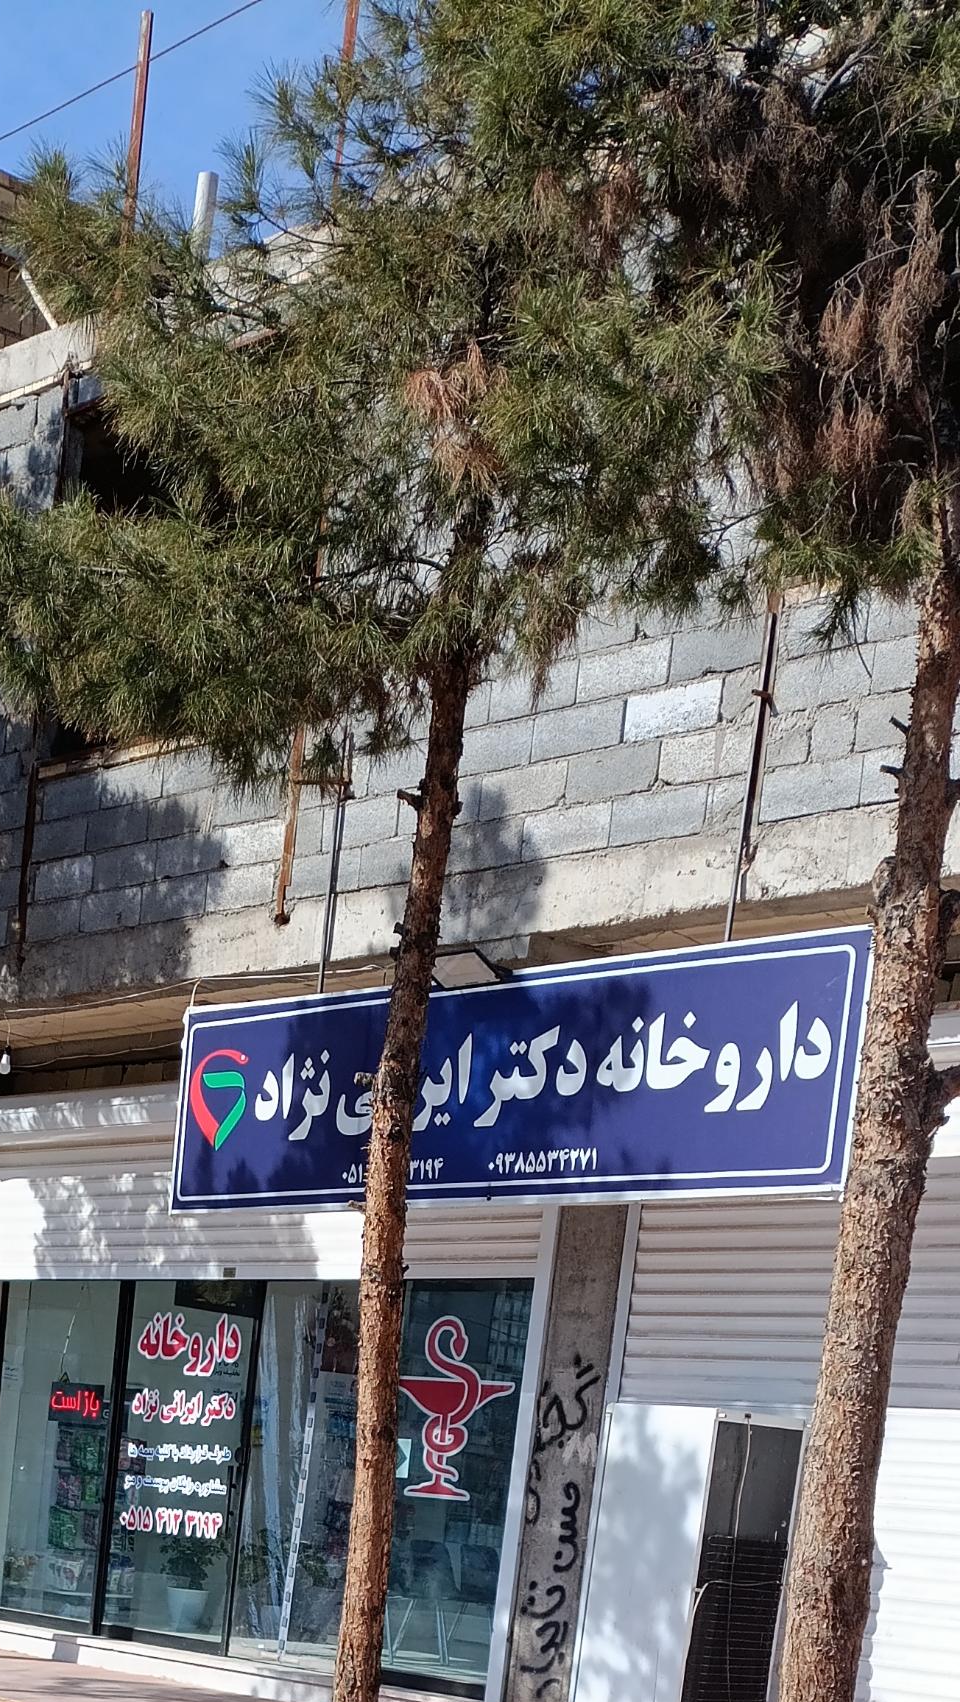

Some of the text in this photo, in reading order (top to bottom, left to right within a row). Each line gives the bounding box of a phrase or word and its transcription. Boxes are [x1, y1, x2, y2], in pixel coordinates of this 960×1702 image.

[254, 1000, 832, 1141] داروخانه دکتر ایری نژاد
[488, 1147, 598, 1175] ۰۹۳۸۵۵۳۴۲۷۱
[138, 1312, 241, 1376] داروخانه
[51, 1390, 100, 1417] باز است
[132, 1387, 160, 1422] نژاد
[160, 1389, 204, 1424] ایرانی
[201, 1392, 236, 1427] دکتر
[128, 1442, 138, 1457] ها
[138, 1444, 155, 1461] بیمه
[179, 1444, 208, 1465] قرارداد
[208, 1444, 232, 1465] طرف
[124, 1474, 227, 1497] مشاوره رایگان پوست و مو
[119, 1505, 153, 1532] ۰۵۱۵
[185, 1510, 222, 1539] ۳۱۹۴
